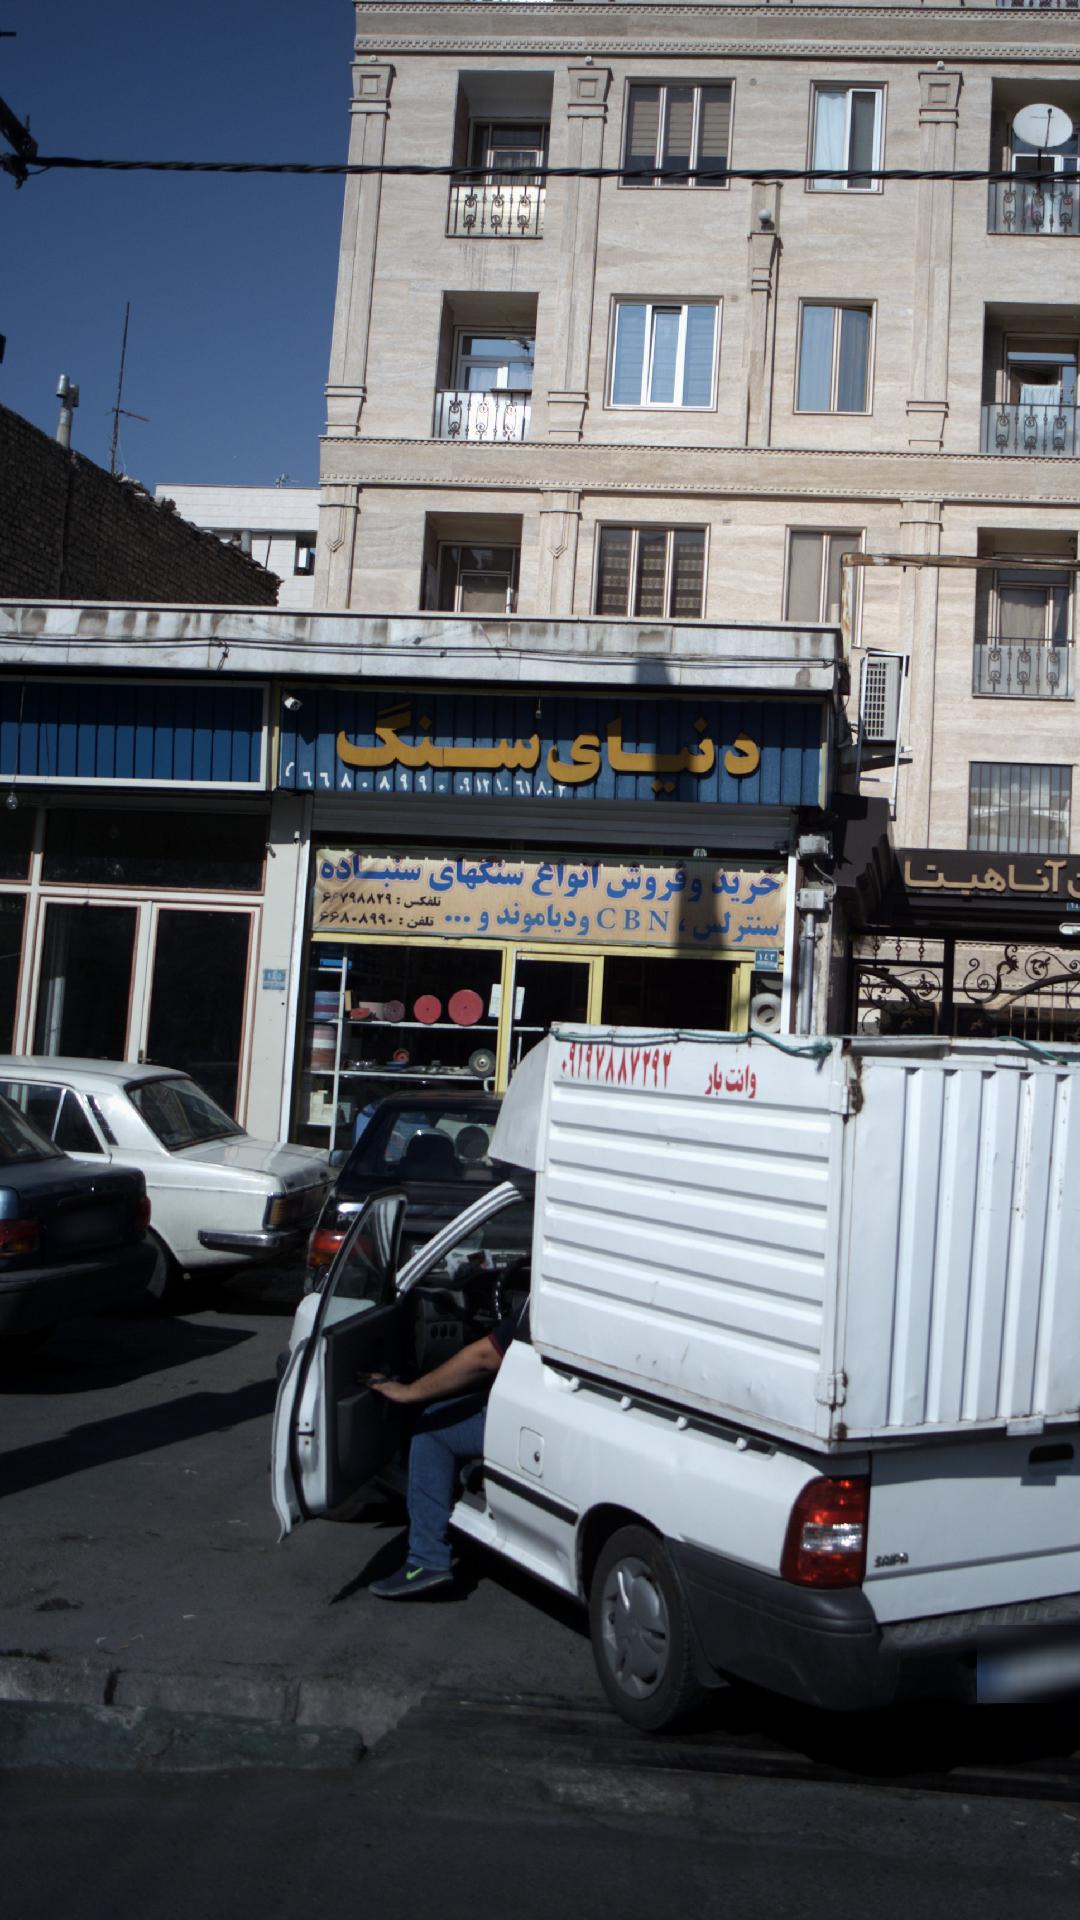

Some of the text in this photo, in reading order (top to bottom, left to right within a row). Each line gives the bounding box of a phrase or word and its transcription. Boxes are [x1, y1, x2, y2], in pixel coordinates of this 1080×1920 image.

[336, 701, 760, 794] دنیای سنگ
[320, 854, 421, 888] سنباده
[429, 856, 524, 891] سنگهای
[531, 859, 599, 897] انواع
[711, 867, 781, 904] خرید
[904, 860, 1067, 895] آناهیتا
[596, 907, 670, 932] CBN
[704, 1061, 757, 1099] وانت بار
